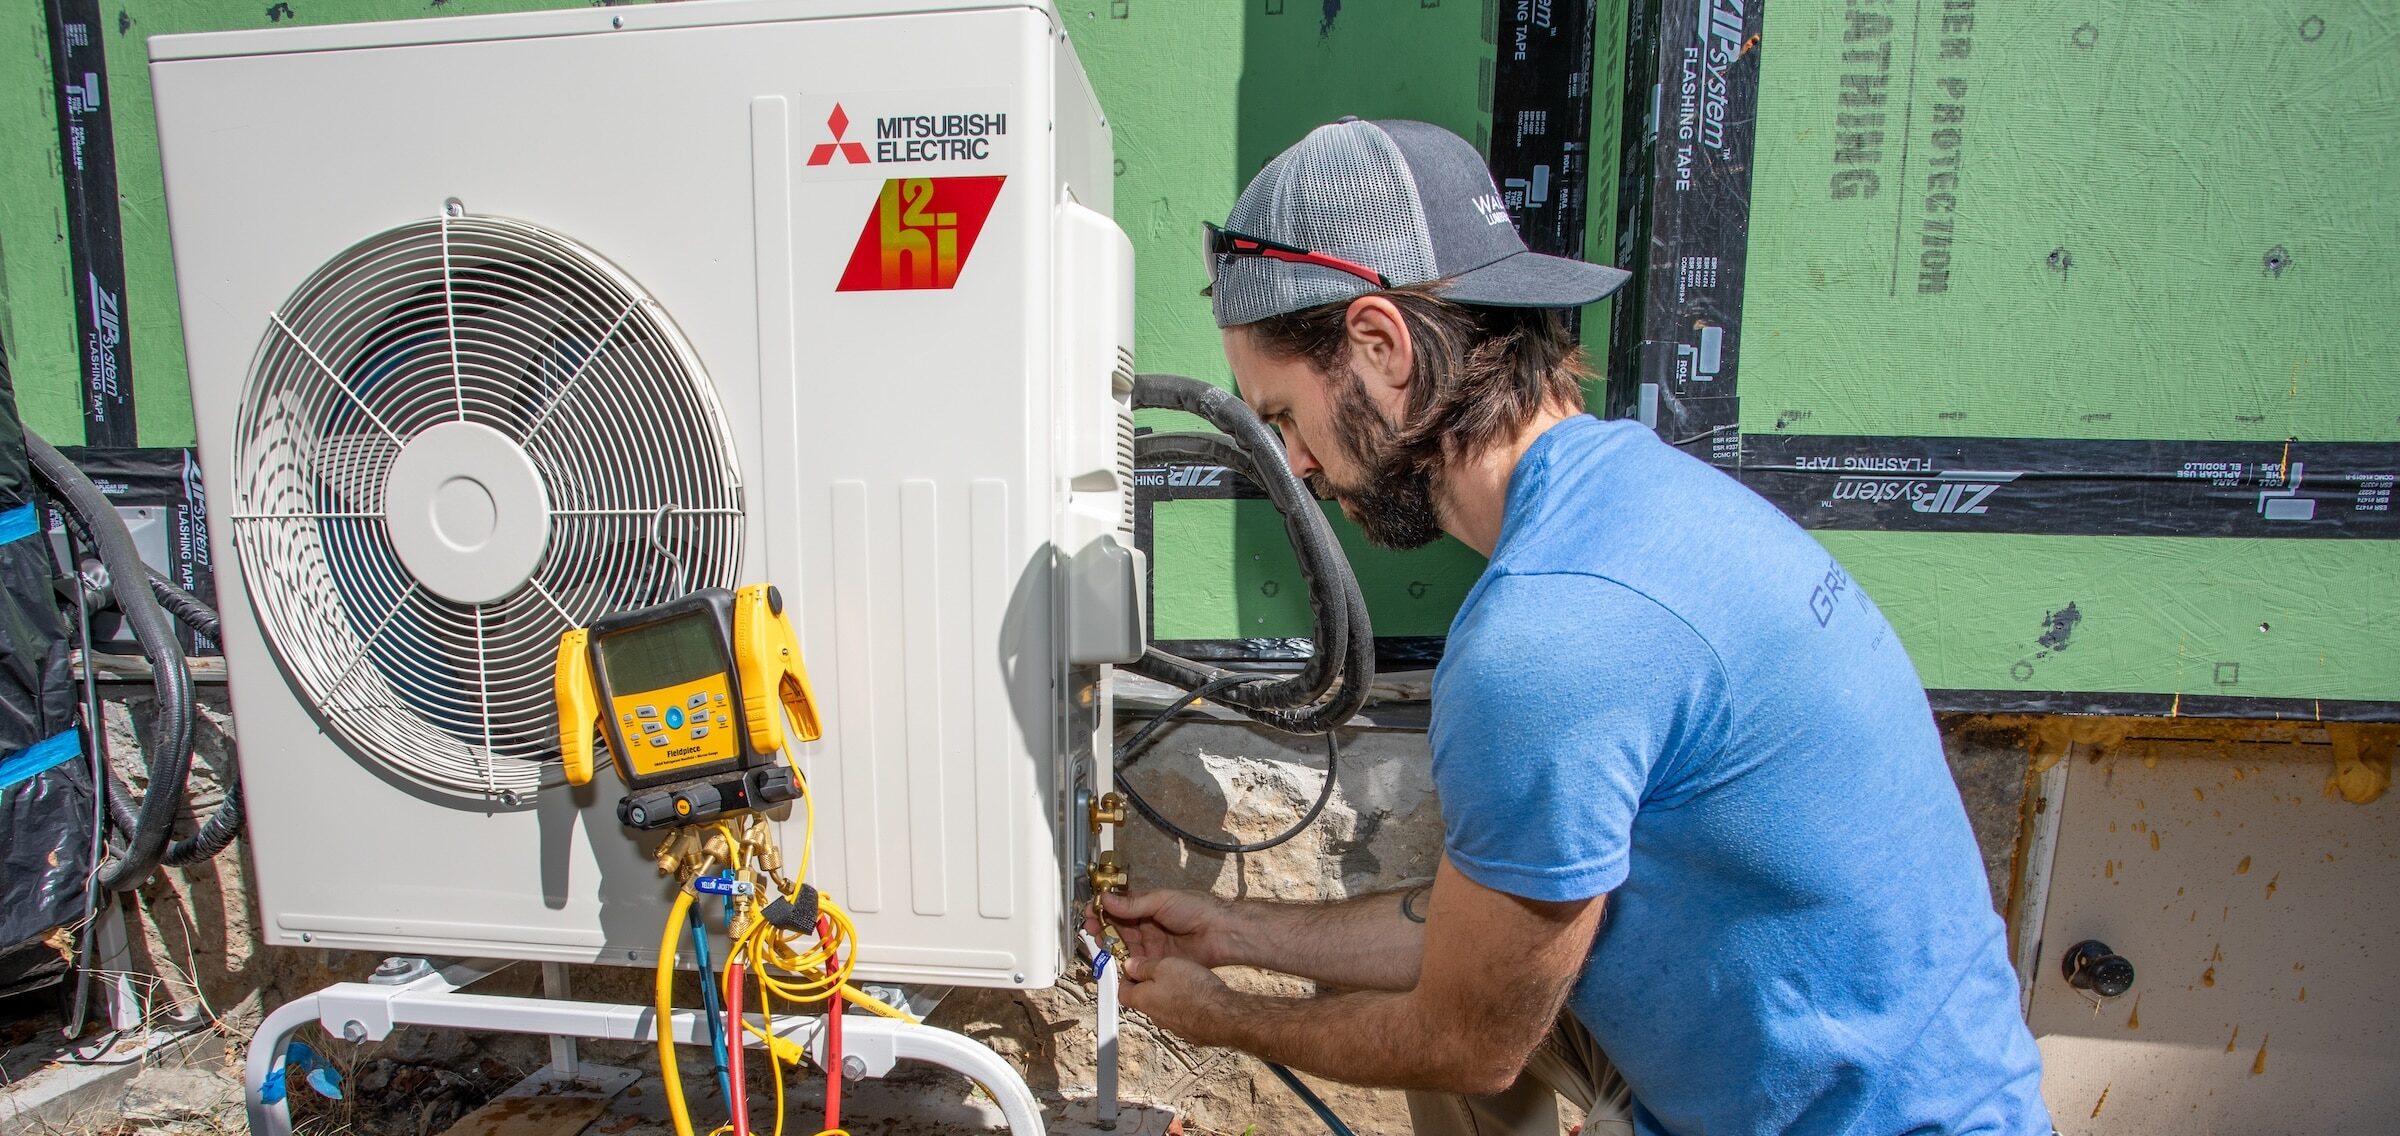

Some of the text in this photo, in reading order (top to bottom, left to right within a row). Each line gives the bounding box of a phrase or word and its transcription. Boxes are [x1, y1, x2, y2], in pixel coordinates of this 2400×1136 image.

[1514, 24, 1528, 61] TAPE
[1830, 0, 1894, 200] ATHING
[877, 113, 1007, 139] MITSUBISHI
[1675, 47, 1698, 192] FLASHING TAPE
[877, 138, 990, 163] ELECTRIC
[1562, 154, 1570, 175] ROLL
[1917, 77, 1969, 294] PROTECTION
[1561, 188, 1569, 209] PARA
[89, 332, 105, 423] FLASHING TAPE
[1679, 360, 1688, 385] ROLL
[1795, 456, 1932, 471] FLASHING TAPE
[2176, 470, 2241, 478] APLICAR USE
[2184, 462, 2242, 471] EL RODILLO
[2261, 463, 2281, 471] APE
[2212, 478, 2238, 486] PARA
[177, 504, 194, 591] FLASHING TAPE
[667, 745, 701, 758] Fieldpiece
